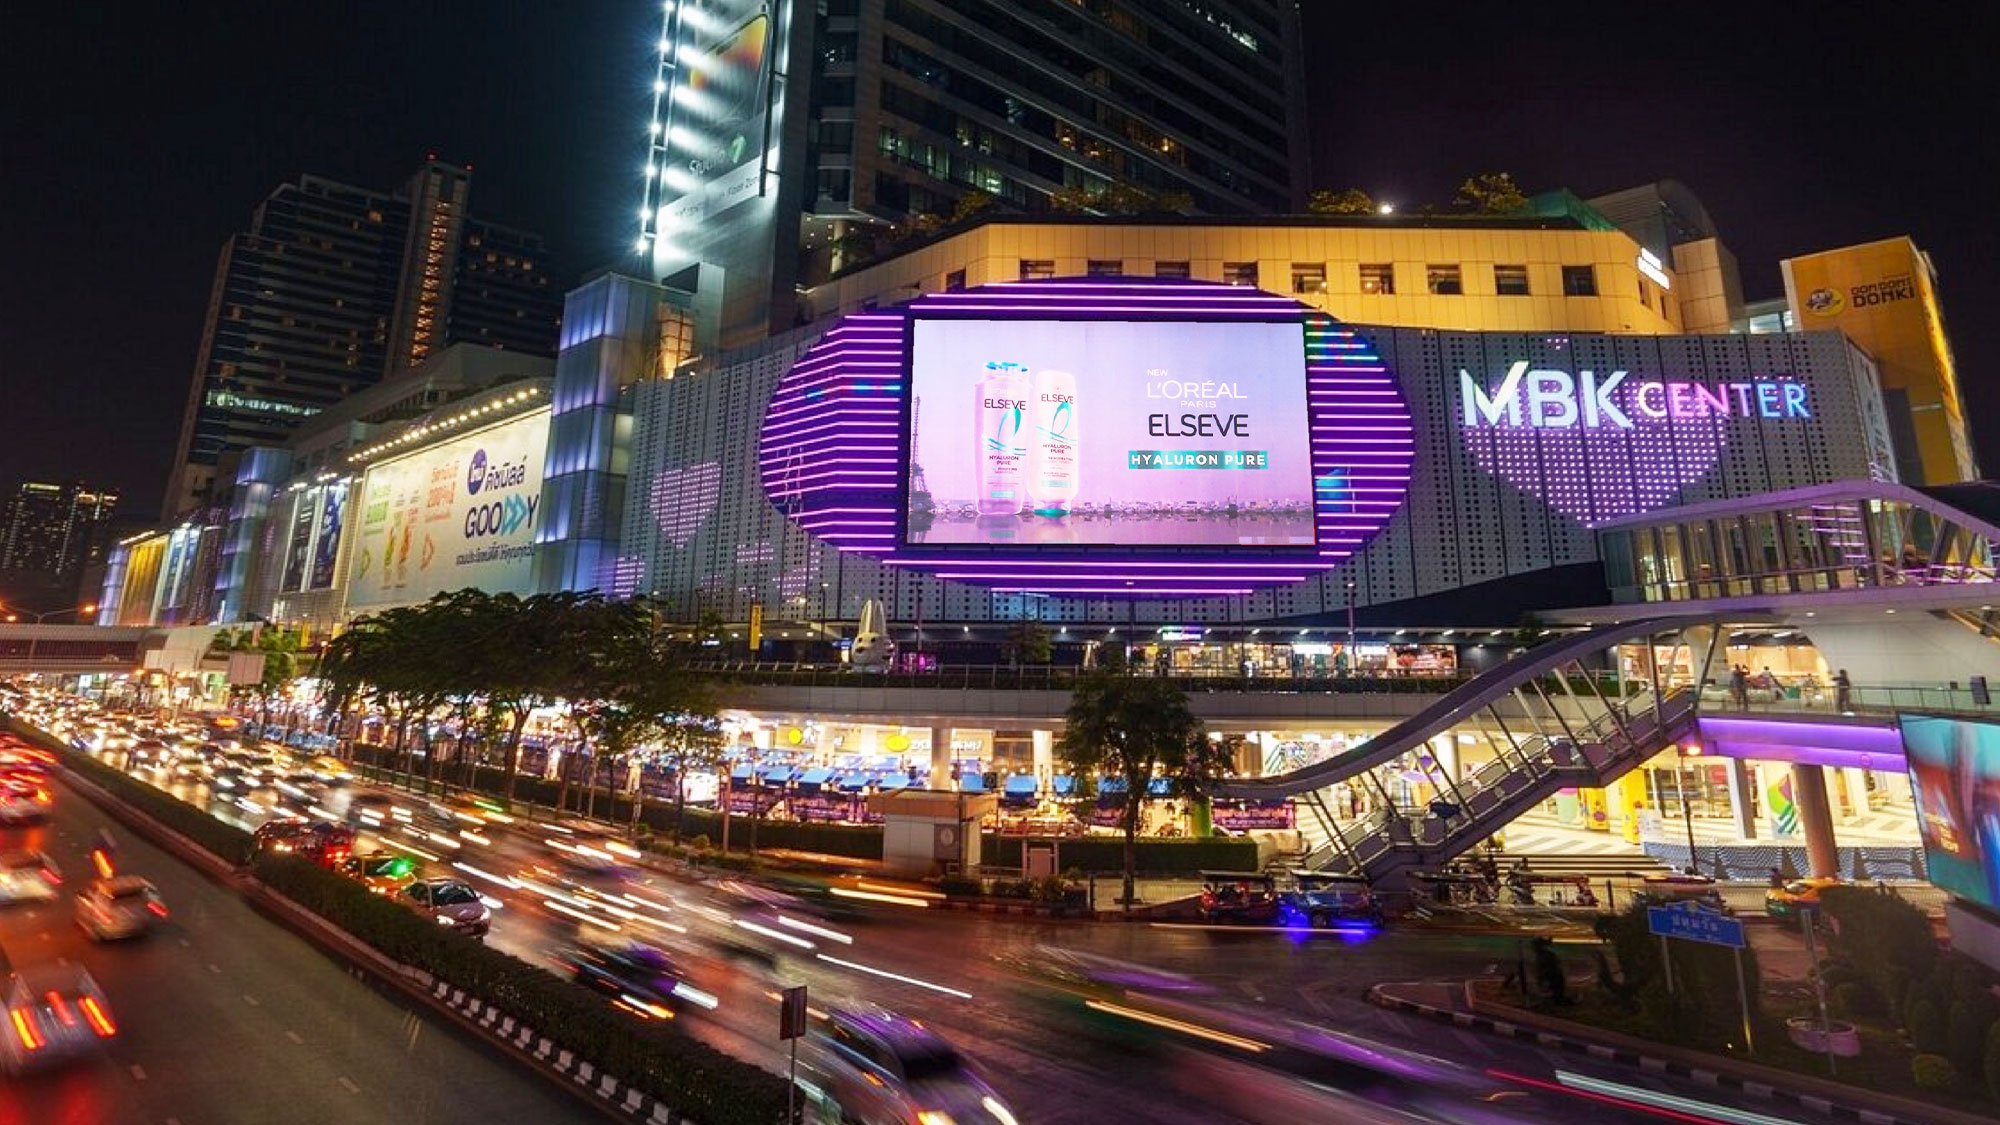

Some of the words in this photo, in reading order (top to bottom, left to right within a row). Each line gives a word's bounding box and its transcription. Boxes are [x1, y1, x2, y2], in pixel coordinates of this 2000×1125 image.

[1853, 286, 1915, 308] DONKI
[1146, 368, 1169, 377] NEW
[1146, 379, 1249, 399] L'ORÉAL
[1461, 361, 1634, 429] MBK
[1638, 382, 1812, 419] CENTER
[984, 398, 1027, 411] ELSEVE
[1041, 394, 1073, 404] ELSEVE
[1180, 400, 1217, 409] PARIS
[1148, 413, 1250, 437] ELSEVE
[1131, 454, 1219, 466] HYALURON
[1223, 454, 1266, 466] PURE
